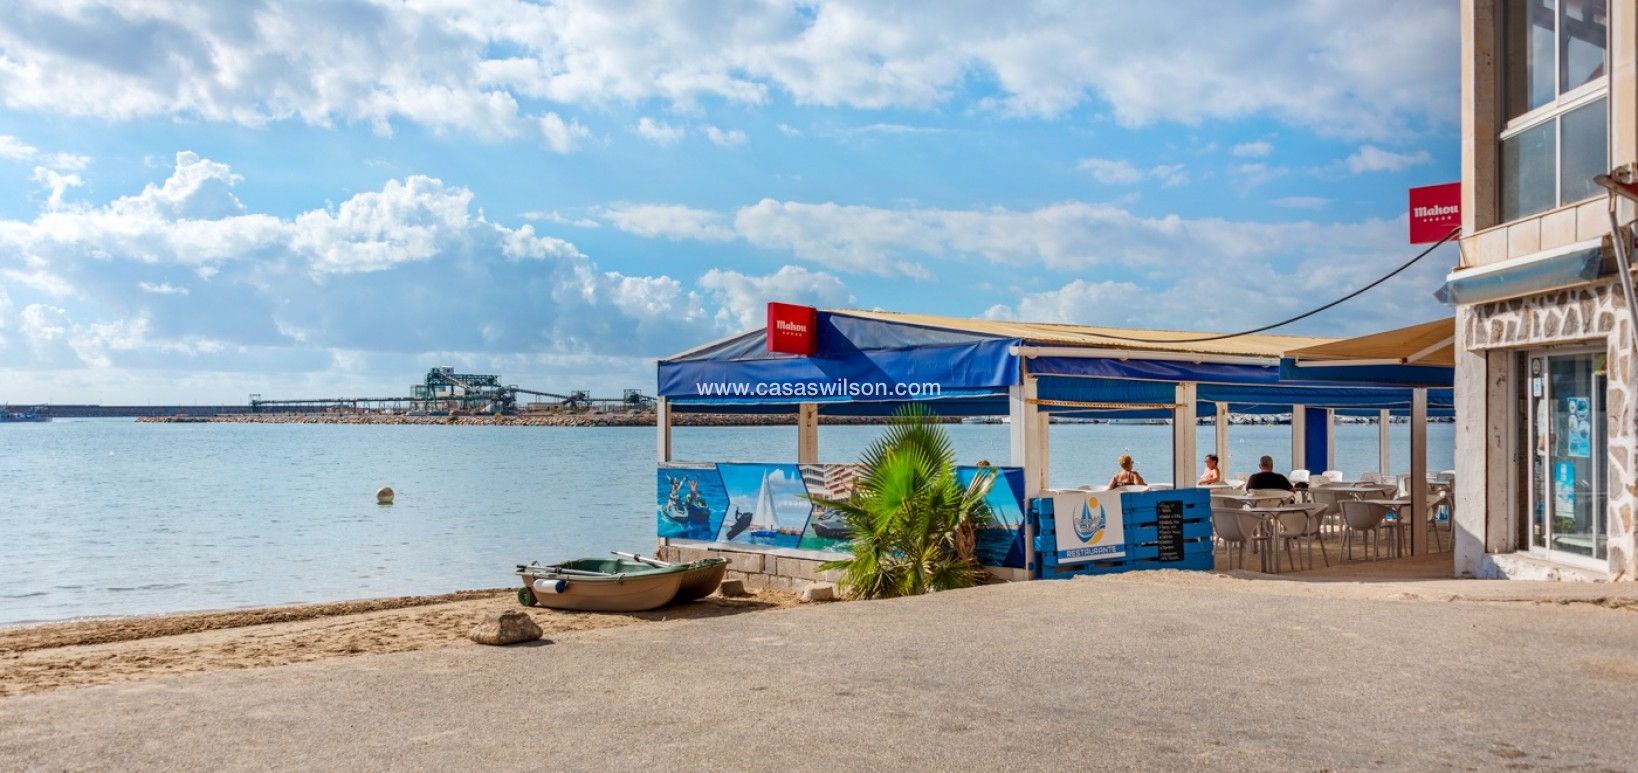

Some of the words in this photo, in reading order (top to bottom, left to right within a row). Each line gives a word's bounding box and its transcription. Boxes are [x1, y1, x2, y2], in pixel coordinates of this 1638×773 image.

[1414, 204, 1459, 218] Mahou
[776, 320, 807, 332] Mahou
[1066, 546, 1117, 558] RESTAURANTE
